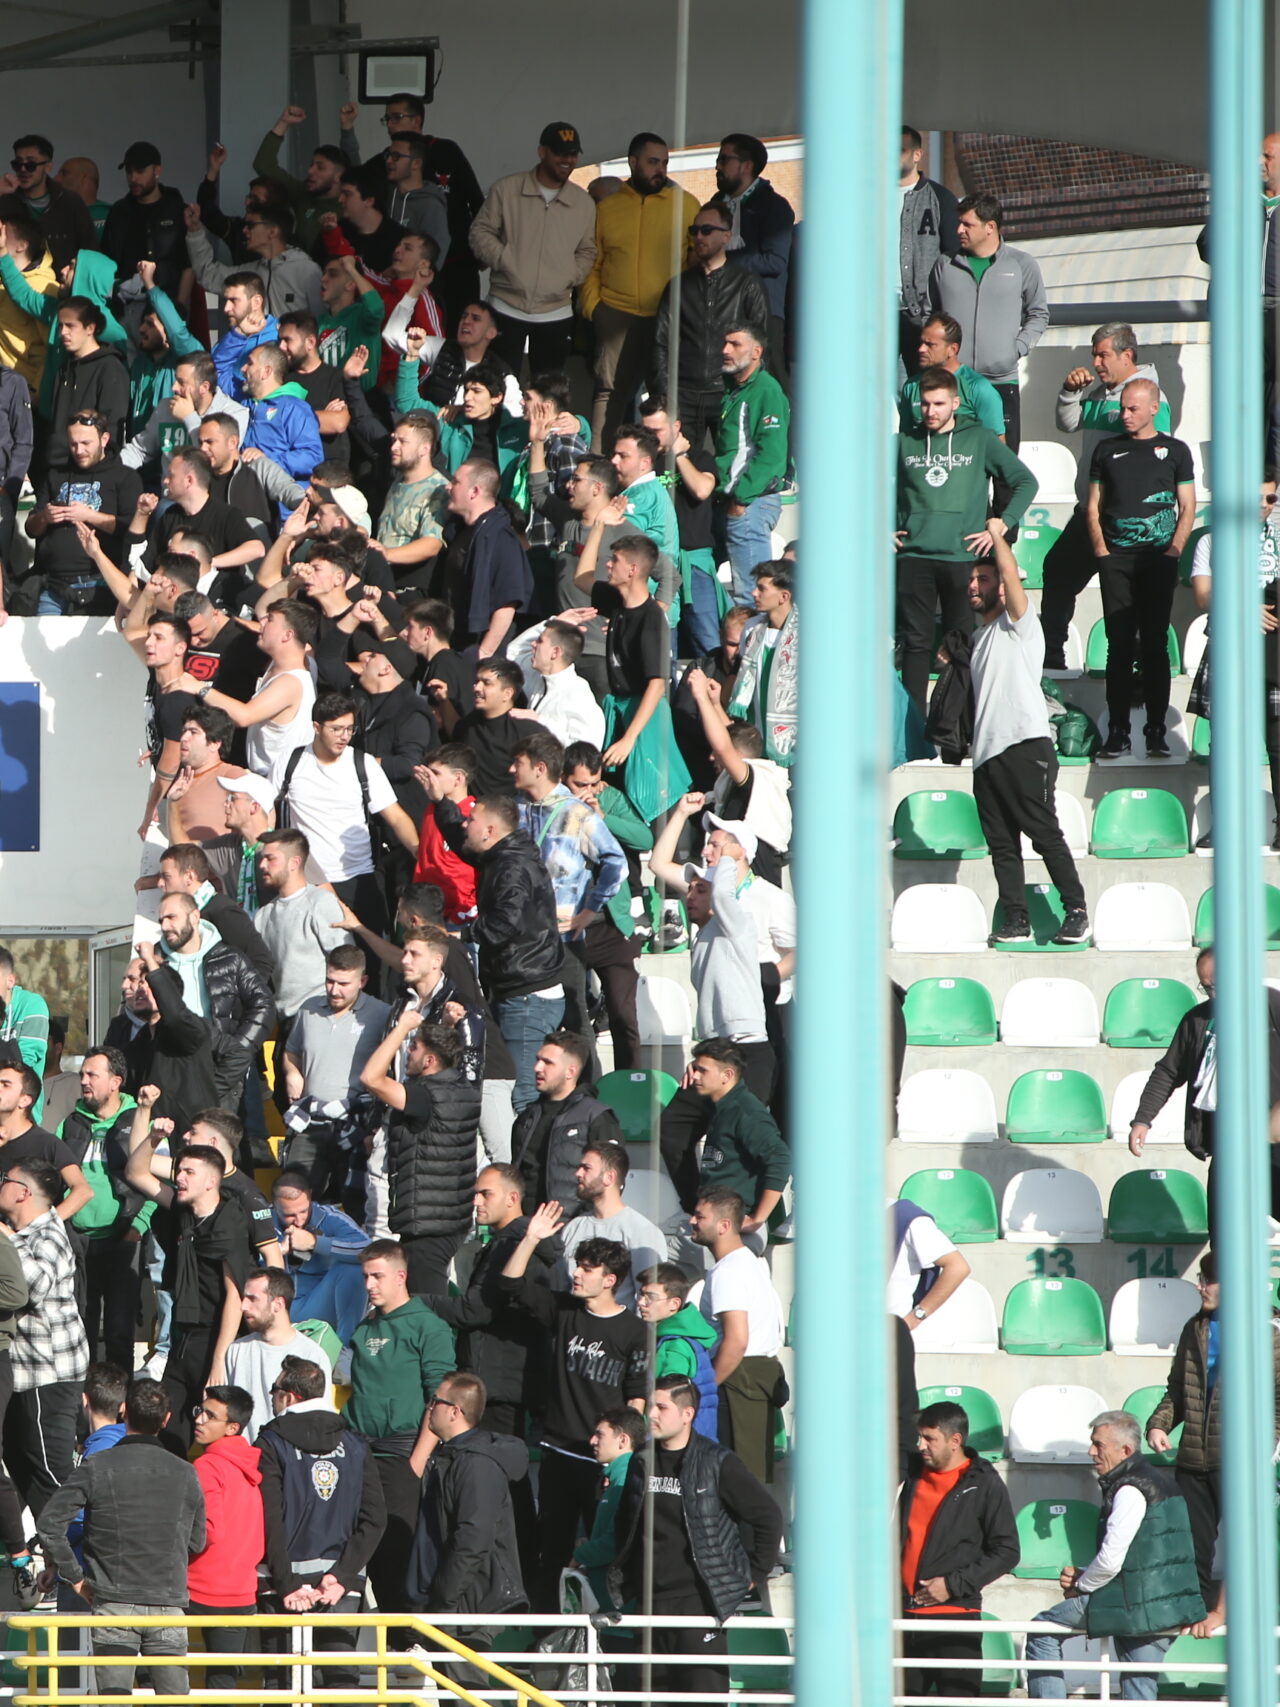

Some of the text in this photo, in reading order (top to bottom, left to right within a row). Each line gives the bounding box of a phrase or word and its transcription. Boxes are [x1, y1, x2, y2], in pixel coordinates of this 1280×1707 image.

[917, 208, 936, 236] A
[1026, 1247, 1076, 1278] 13
[1127, 1247, 1178, 1278] 14
